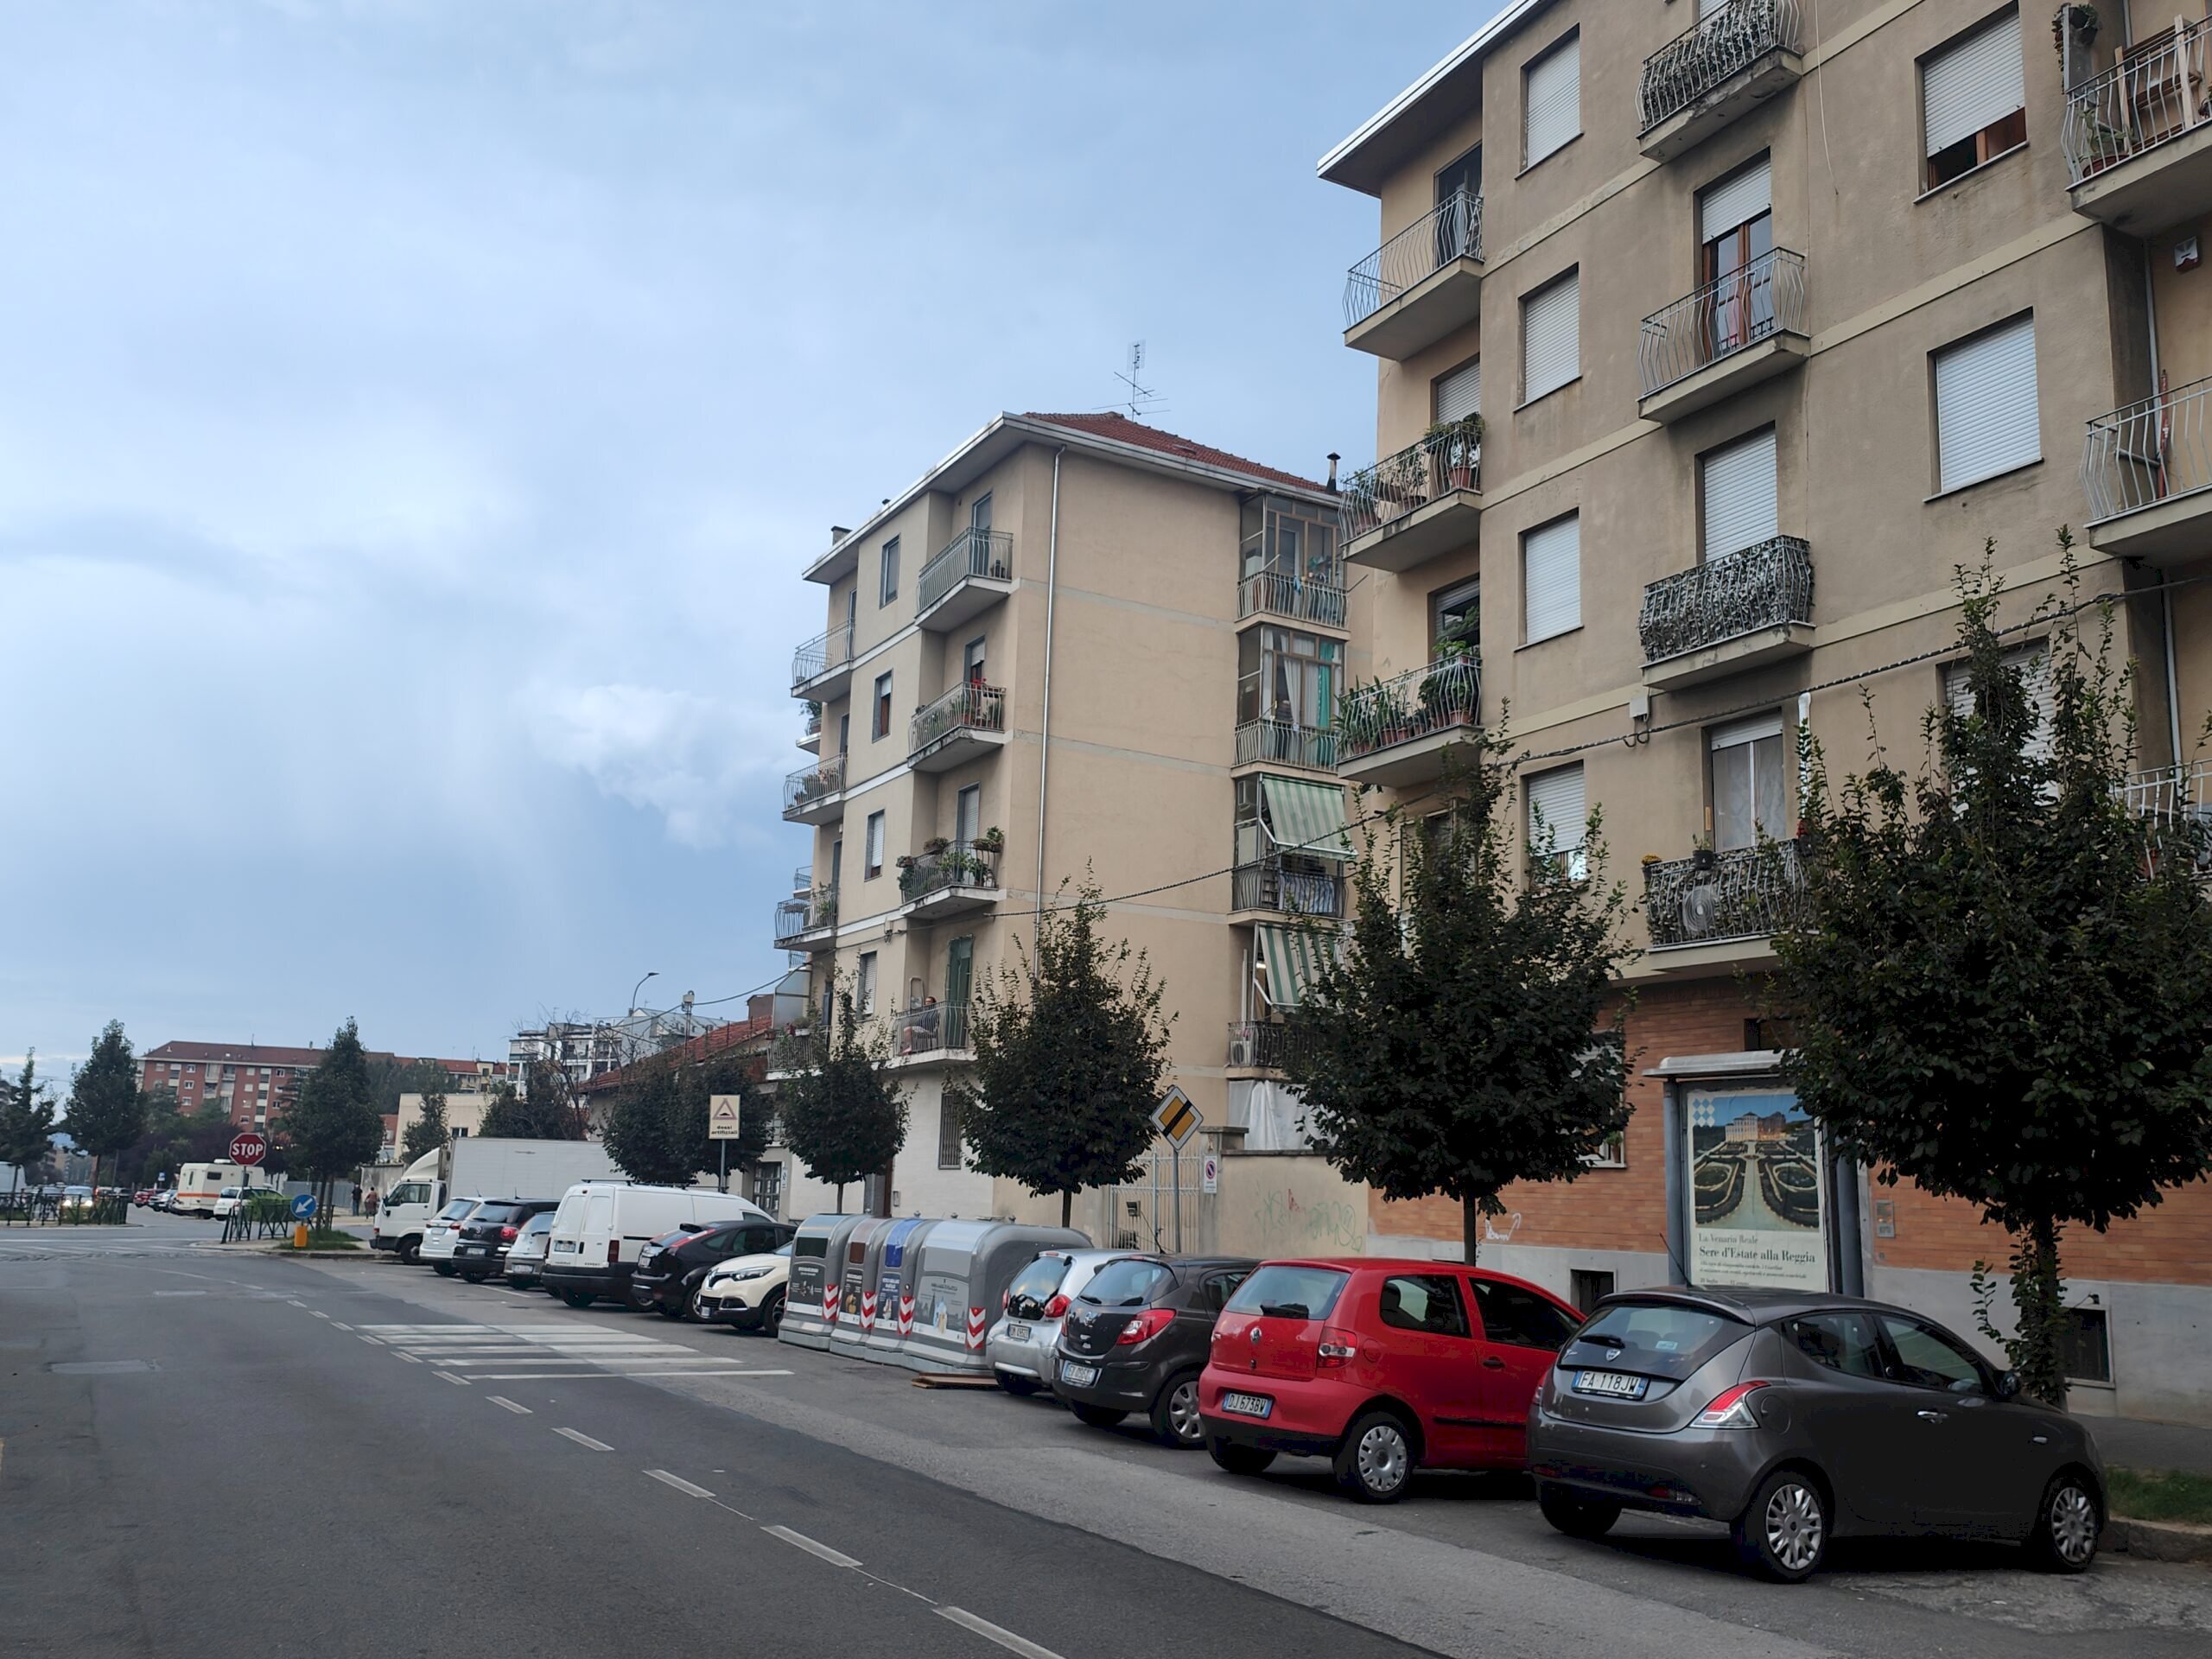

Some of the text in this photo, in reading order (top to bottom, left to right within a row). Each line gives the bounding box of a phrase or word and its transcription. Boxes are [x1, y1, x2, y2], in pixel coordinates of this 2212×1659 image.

[232, 1142, 264, 1156] STOP
[1699, 1233, 1758, 1245] La Venaria Reale
[1699, 1246, 1815, 1264] Sere d'Estate alla Reggia
[1580, 1371, 1639, 1392] FA 118JW
